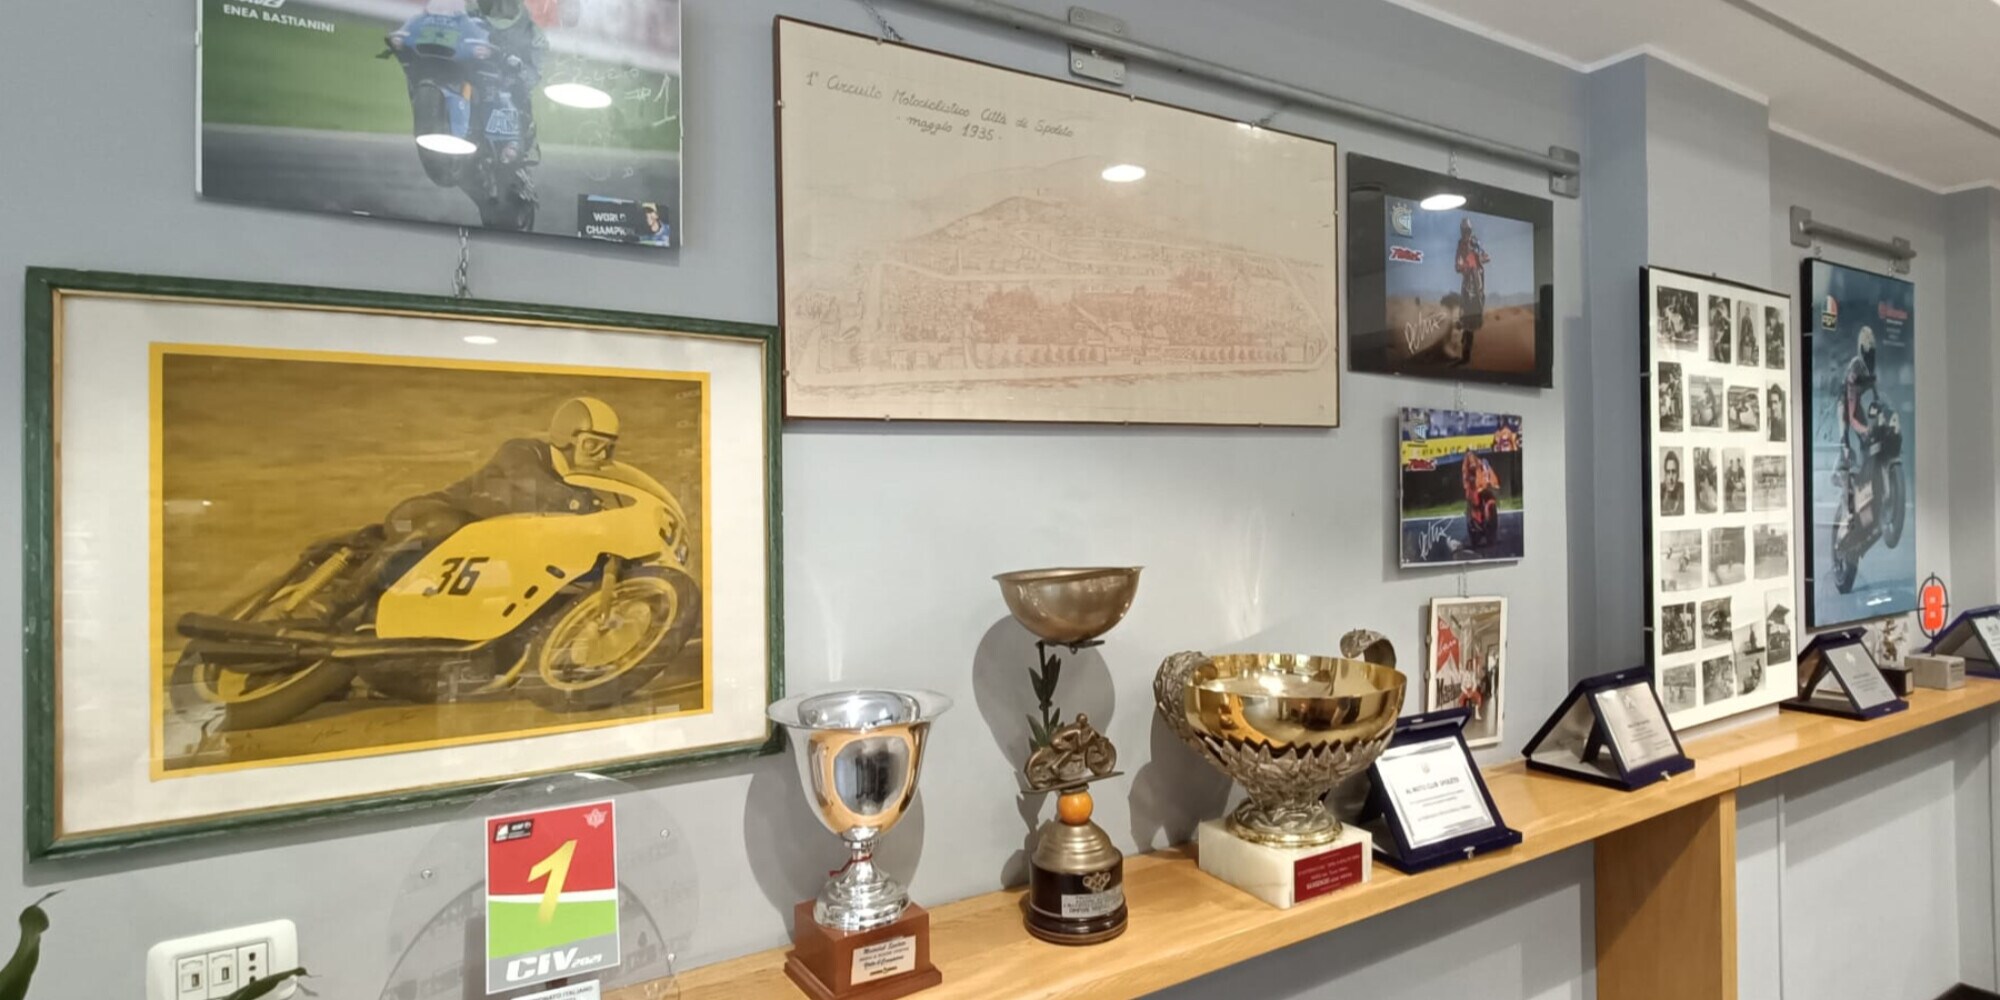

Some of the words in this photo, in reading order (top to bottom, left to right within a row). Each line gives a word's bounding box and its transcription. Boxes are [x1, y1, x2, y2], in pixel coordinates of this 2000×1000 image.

[223, 4, 259, 19] ENEA
[262, 11, 335, 32] BASTIANINI
[827, 74, 882, 99] Circuito
[892, 89, 970, 118] Motociclistico
[980, 107, 1007, 125] Città
[1034, 119, 1074, 138] Spoleto
[906, 116, 953, 136] maggio
[962, 122, 995, 141] 1935
[585, 224, 635, 237] CHAMPI
[422, 556, 490, 597] 36
[528, 839, 578, 927] 1
[506, 947, 578, 982] CIV
